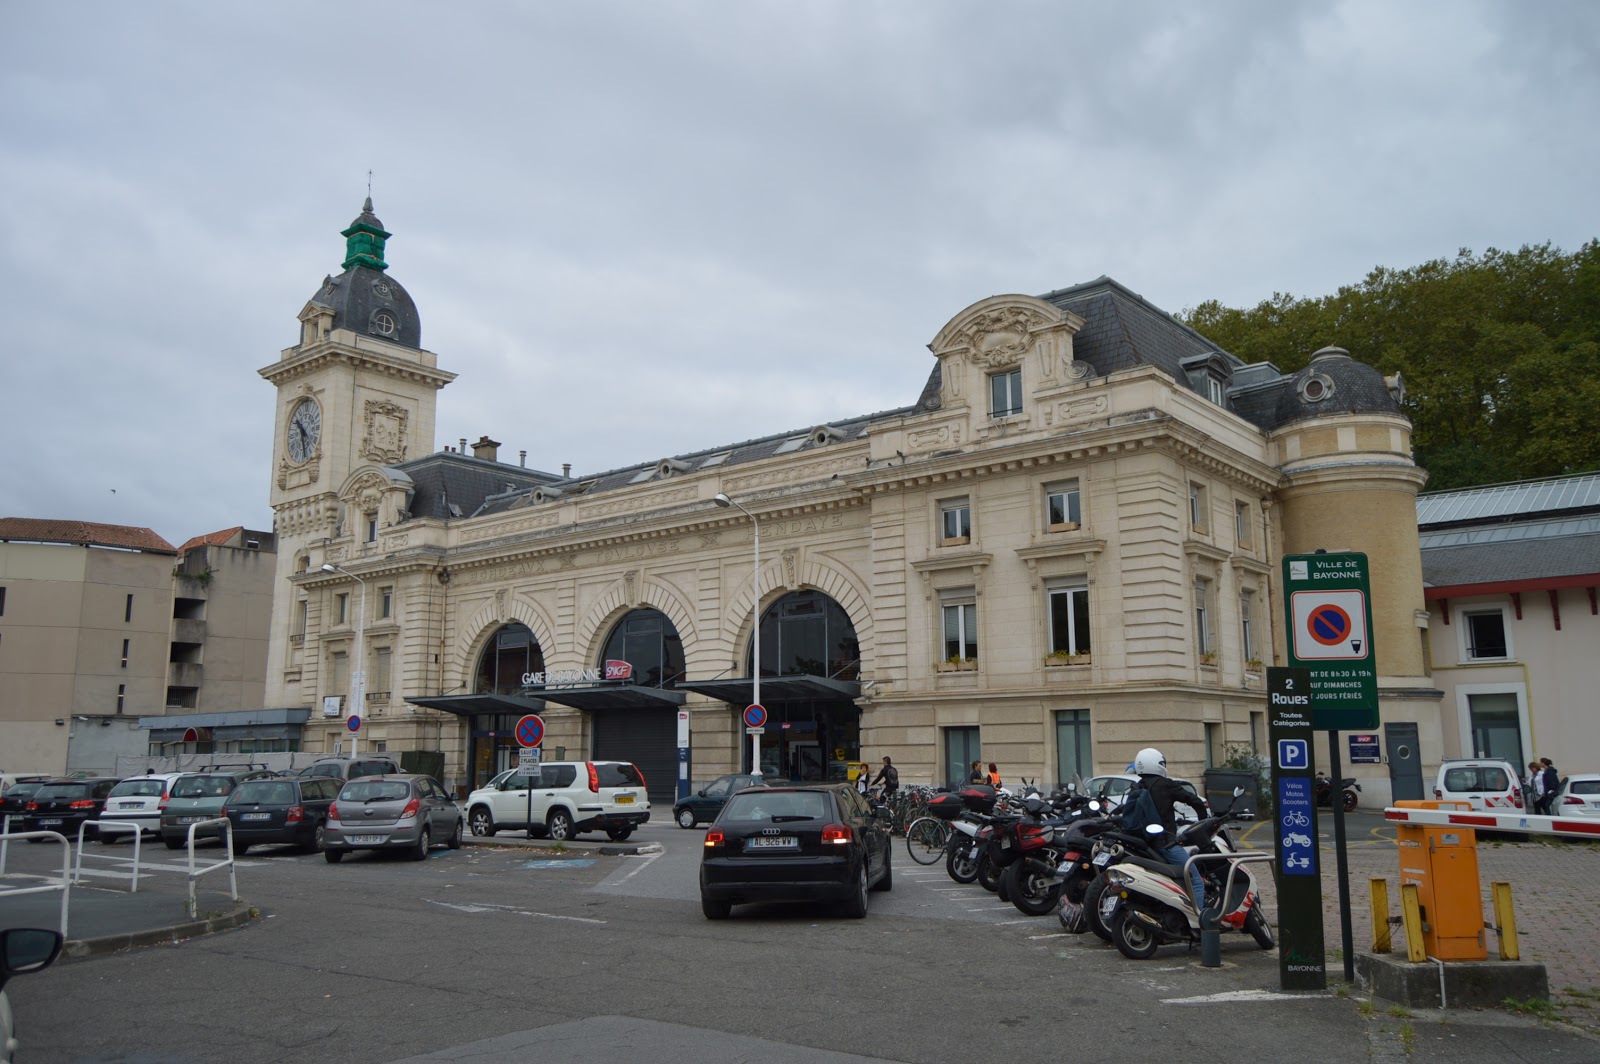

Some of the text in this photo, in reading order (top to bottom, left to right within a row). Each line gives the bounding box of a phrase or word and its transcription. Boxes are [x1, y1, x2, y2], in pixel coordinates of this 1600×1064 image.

[1313, 571, 1361, 579] BAYONNE
[522, 668, 601, 684] GARE DE BAYONNE
[606, 666, 628, 676] SNCF
[1352, 669, 1357, 677] À
[1285, 679, 1293, 689] 2
[1272, 693, 1308, 704] Roues
[1286, 745, 1299, 763] P
